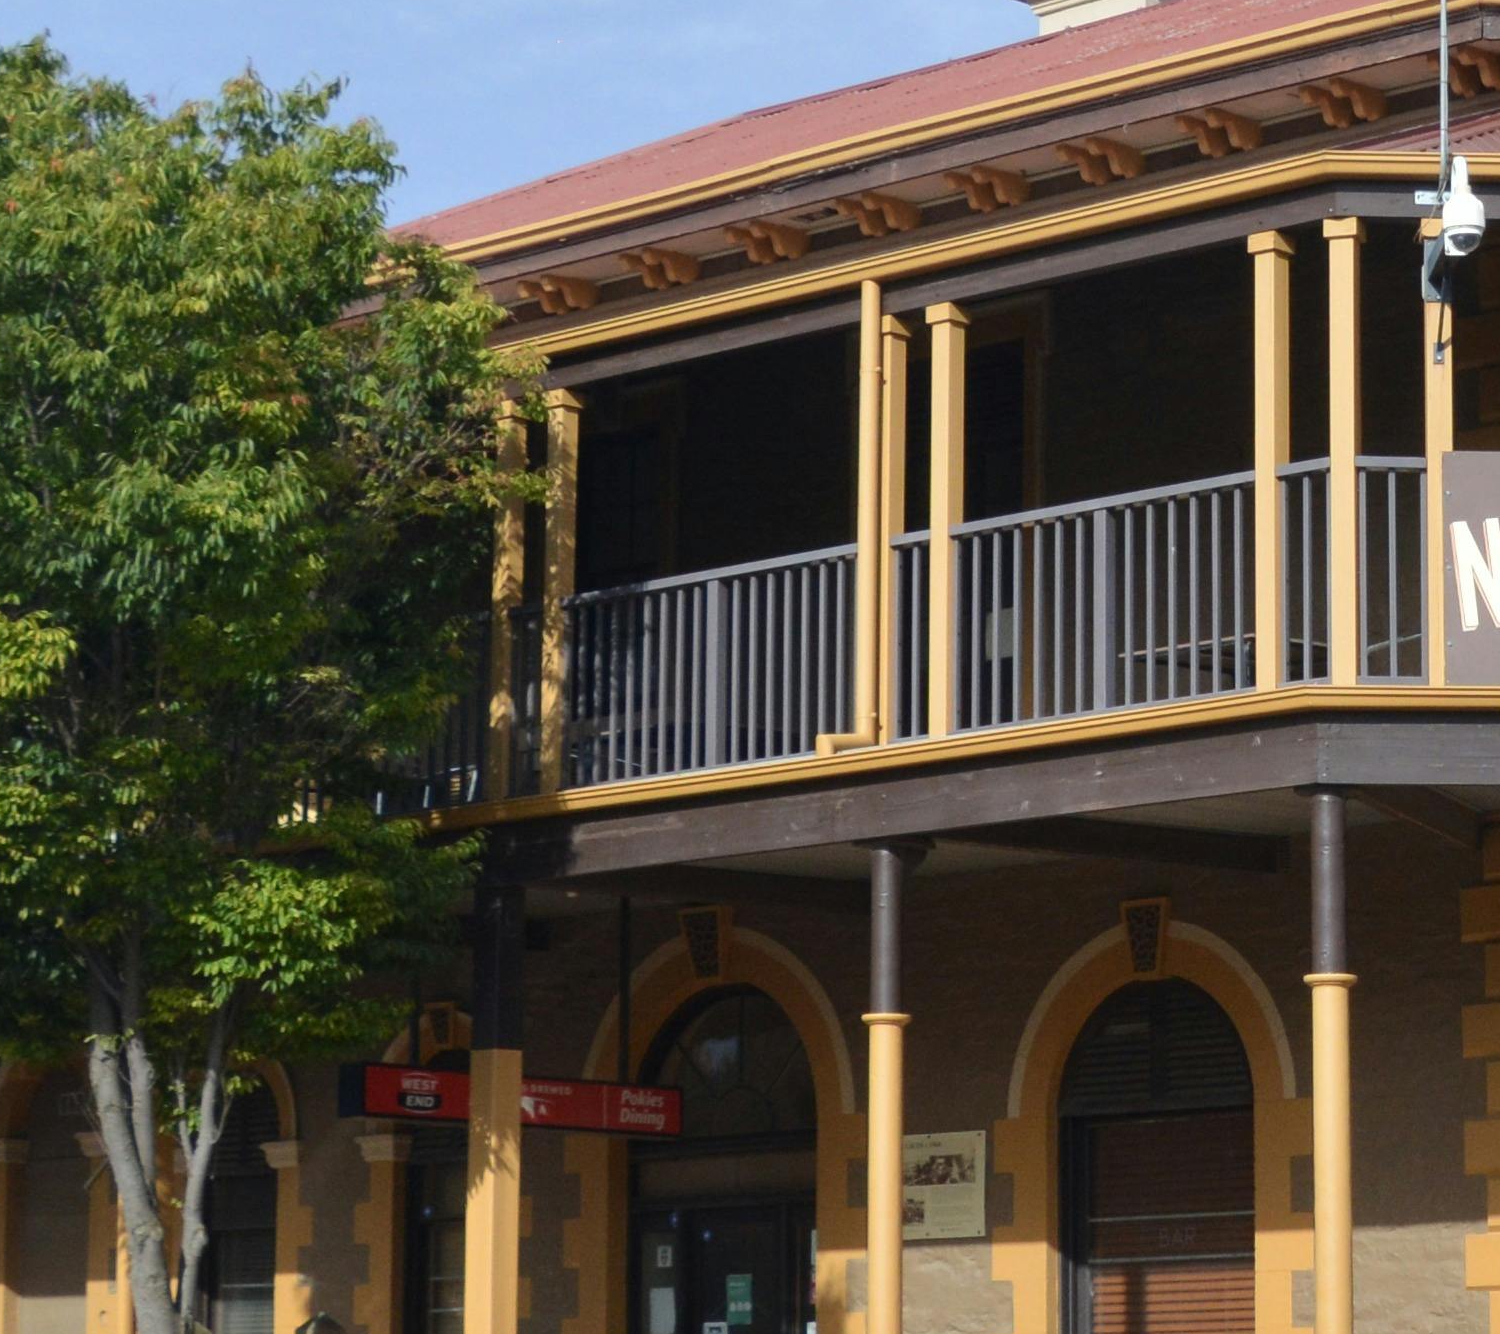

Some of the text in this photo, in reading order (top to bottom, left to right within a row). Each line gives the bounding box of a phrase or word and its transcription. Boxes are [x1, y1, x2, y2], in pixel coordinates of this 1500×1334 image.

[401, 1078, 438, 1092] WEST
[404, 1095, 435, 1109] END
[621, 1090, 665, 1108] Pokies
[619, 1107, 666, 1131] Dining
